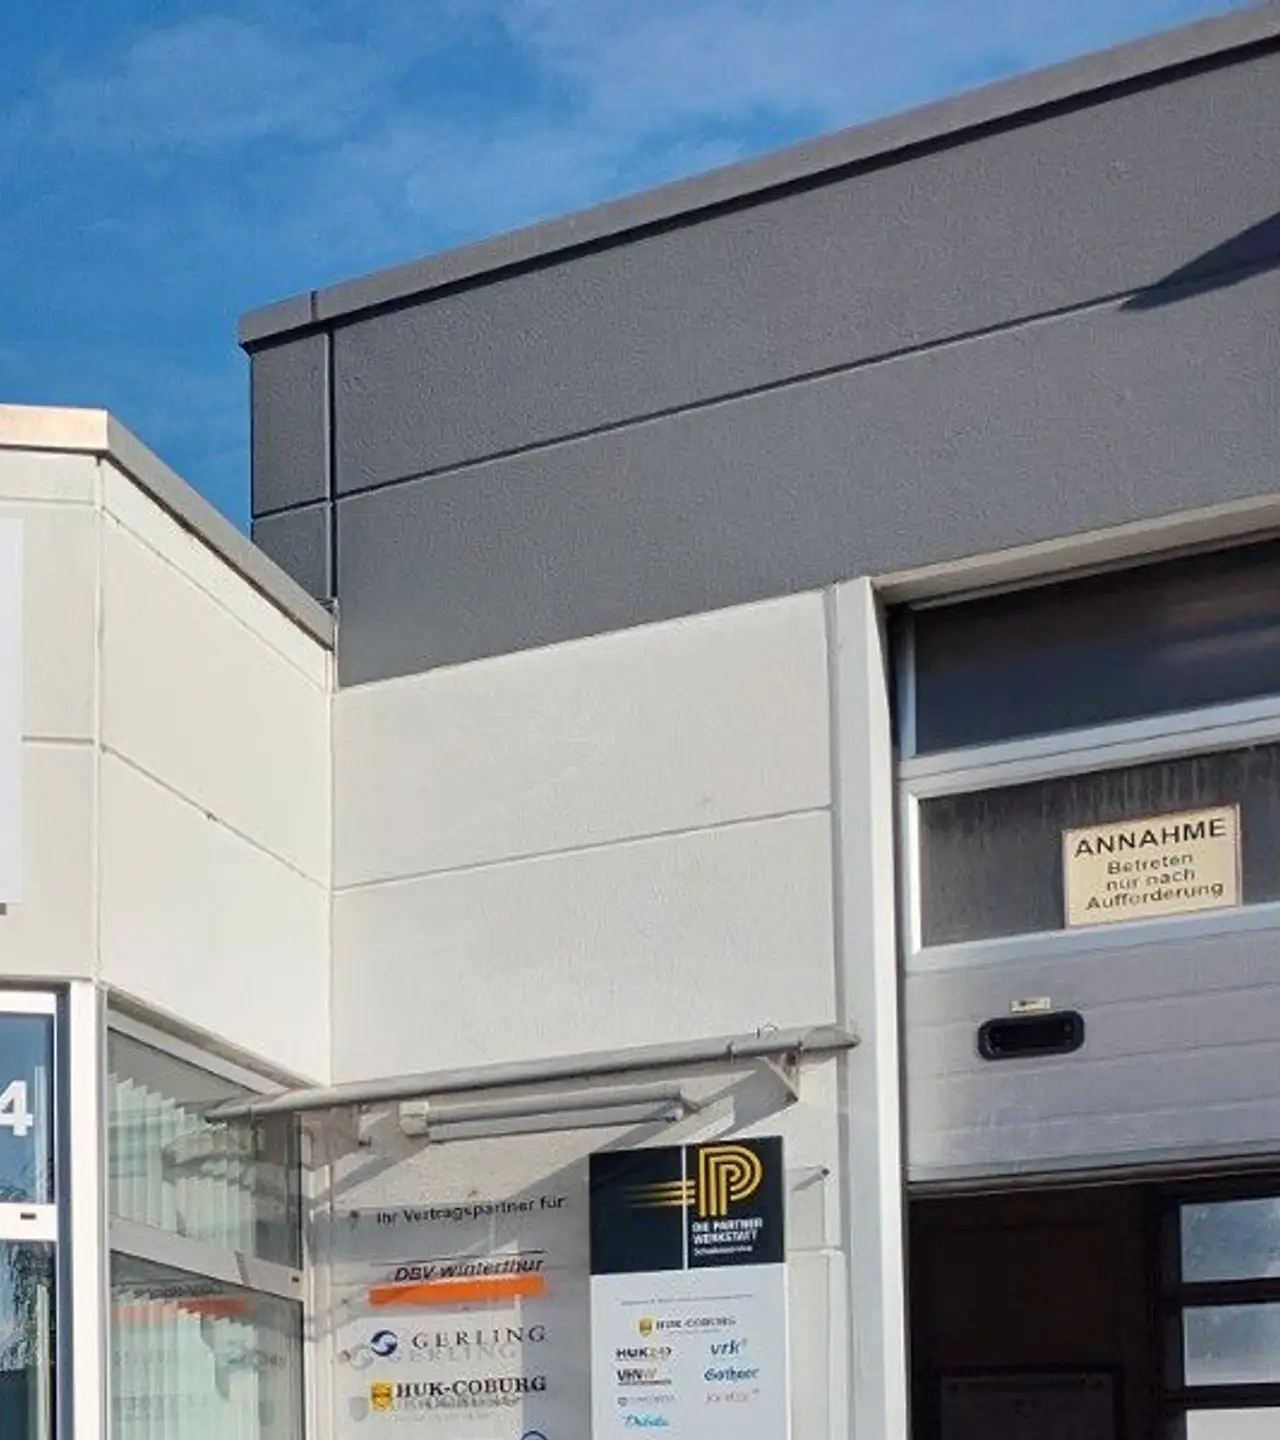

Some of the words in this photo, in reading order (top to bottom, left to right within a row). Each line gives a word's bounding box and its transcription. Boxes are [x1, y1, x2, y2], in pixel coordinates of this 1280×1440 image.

[1074, 818, 1227, 858] ANNAHME
[1107, 852, 1193, 875] Betreten
[1106, 876, 1138, 892] nur
[1145, 868, 1195, 888] nach
[1086, 882, 1225, 911] Aufforderung
[376, 1211, 398, 1228] Ihr
[403, 1199, 535, 1224] Vertragspartner
[540, 1194, 567, 1209] für
[411, 1324, 547, 1350] GERLING
[395, 1375, 548, 1399] HUK-COBURG
